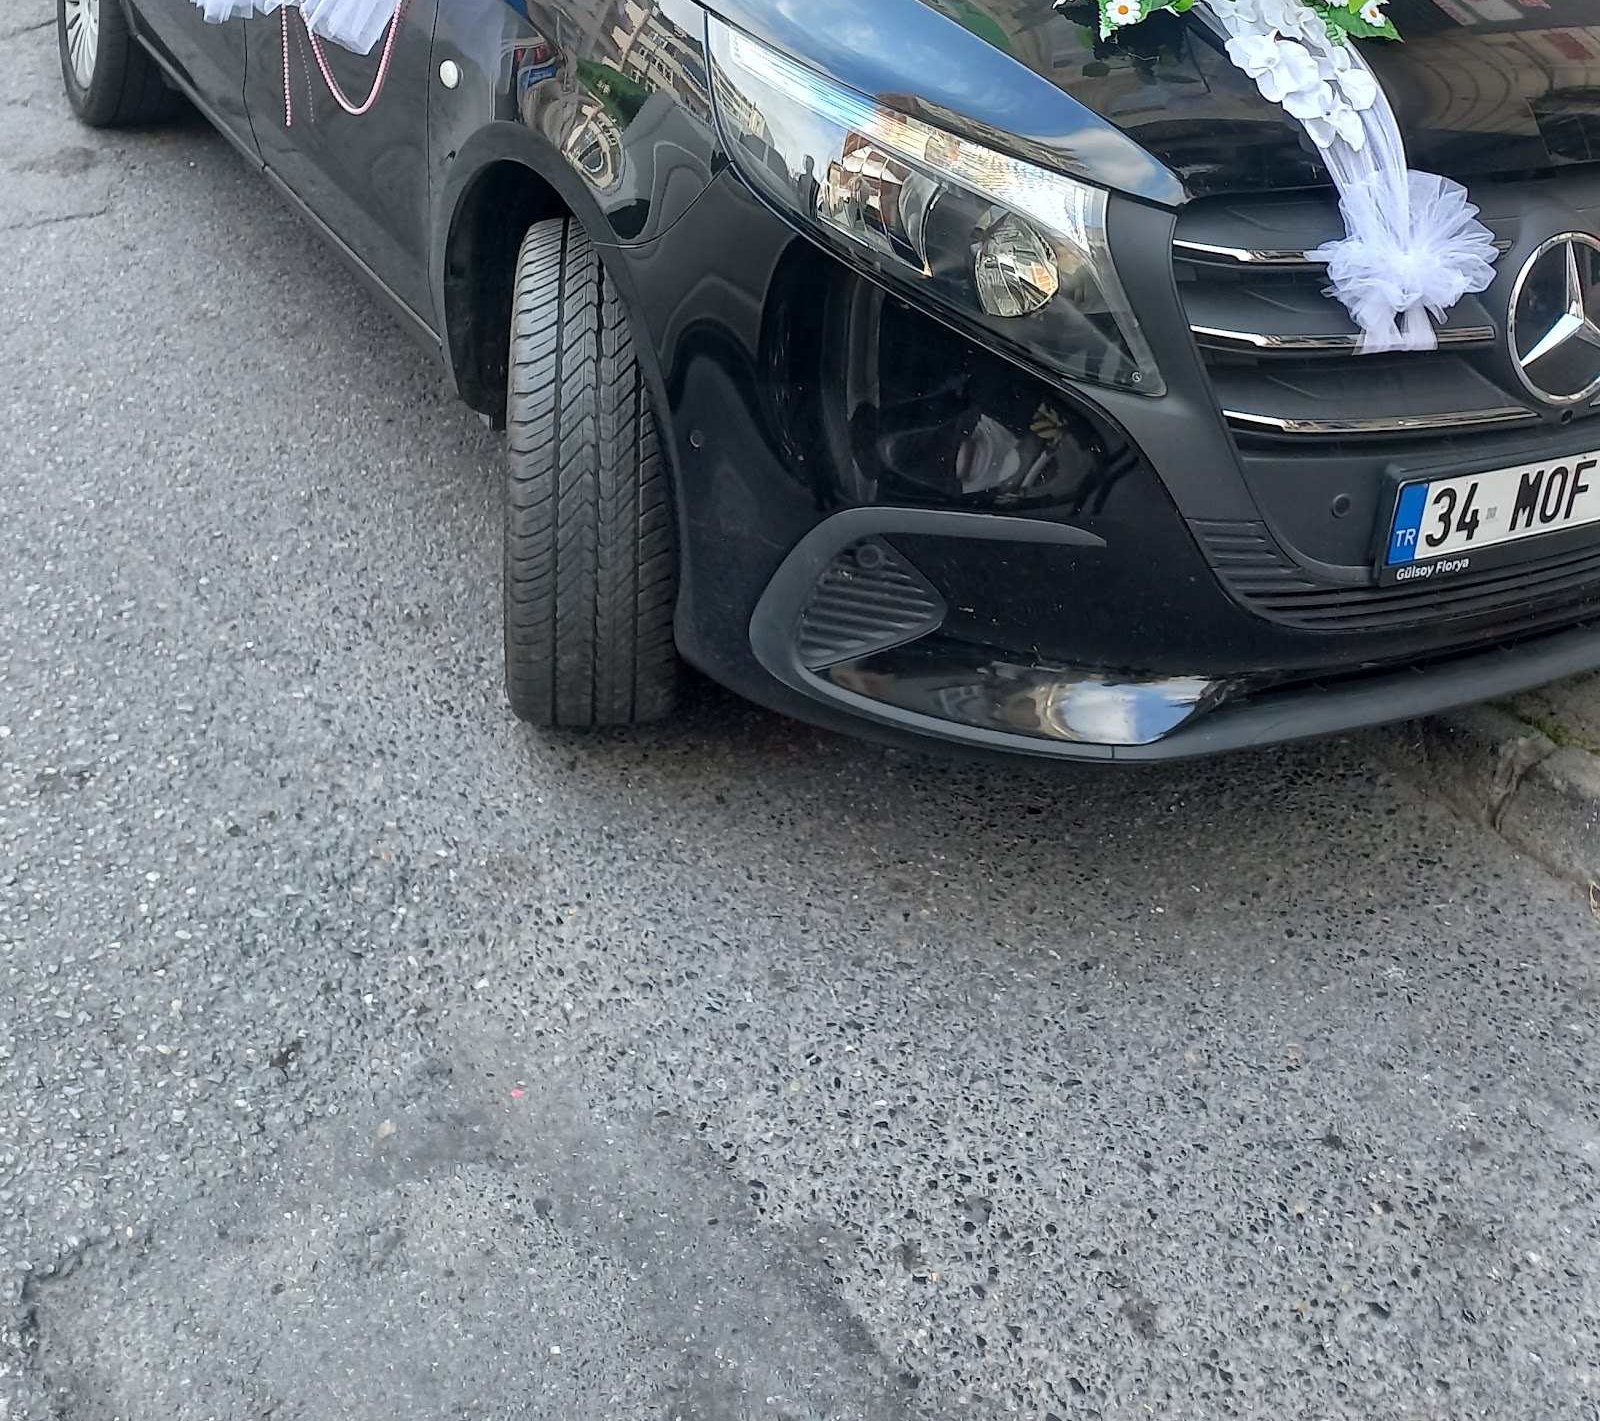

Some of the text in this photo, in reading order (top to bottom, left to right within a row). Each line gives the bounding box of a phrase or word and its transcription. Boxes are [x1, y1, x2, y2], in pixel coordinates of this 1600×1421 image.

[1425, 459, 1597, 547] 34 MOF
[1395, 528, 1417, 547] TR
[1396, 557, 1469, 580] Gülsoy Florya
